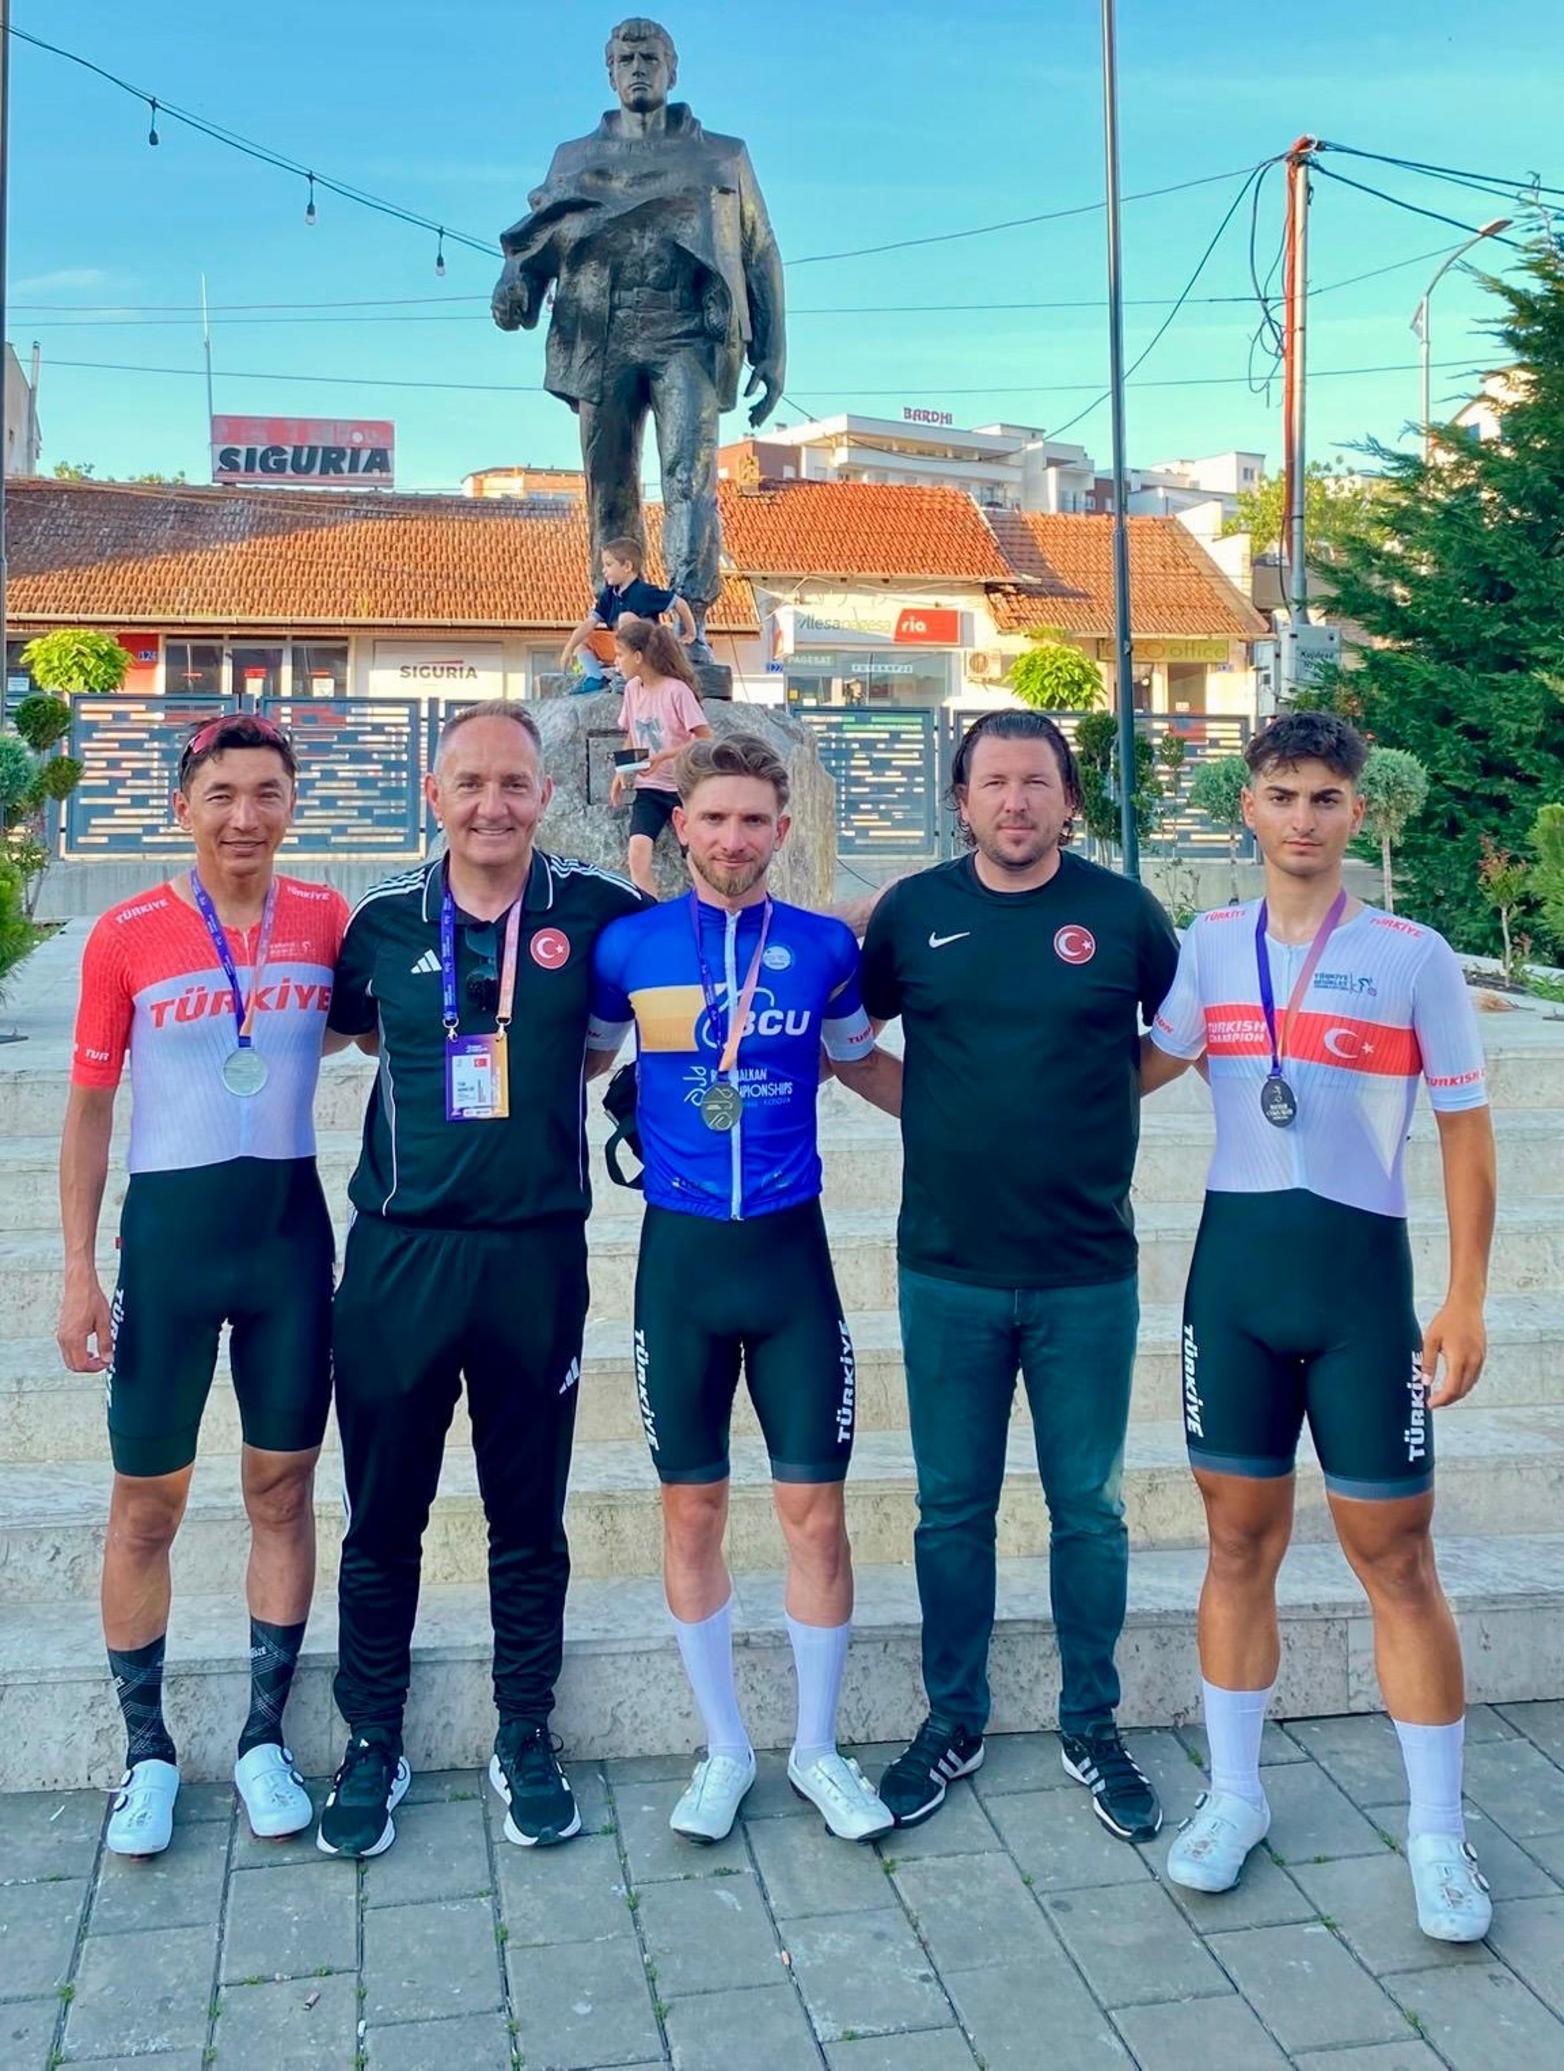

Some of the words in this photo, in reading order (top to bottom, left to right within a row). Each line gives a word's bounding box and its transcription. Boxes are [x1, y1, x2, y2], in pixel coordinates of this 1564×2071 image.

[903, 407, 953, 424] BARDHI
[217, 445, 391, 475] SIGURIA
[901, 615, 927, 632] ria
[400, 665, 478, 679] SIGURIA
[634, 1328, 660, 1451] TÜRKİYE
[836, 1319, 854, 1444] TÜRKİYE
[1184, 1324, 1204, 1438] TÜRKİYE
[1404, 1351, 1426, 1462] TÜRKİYE
